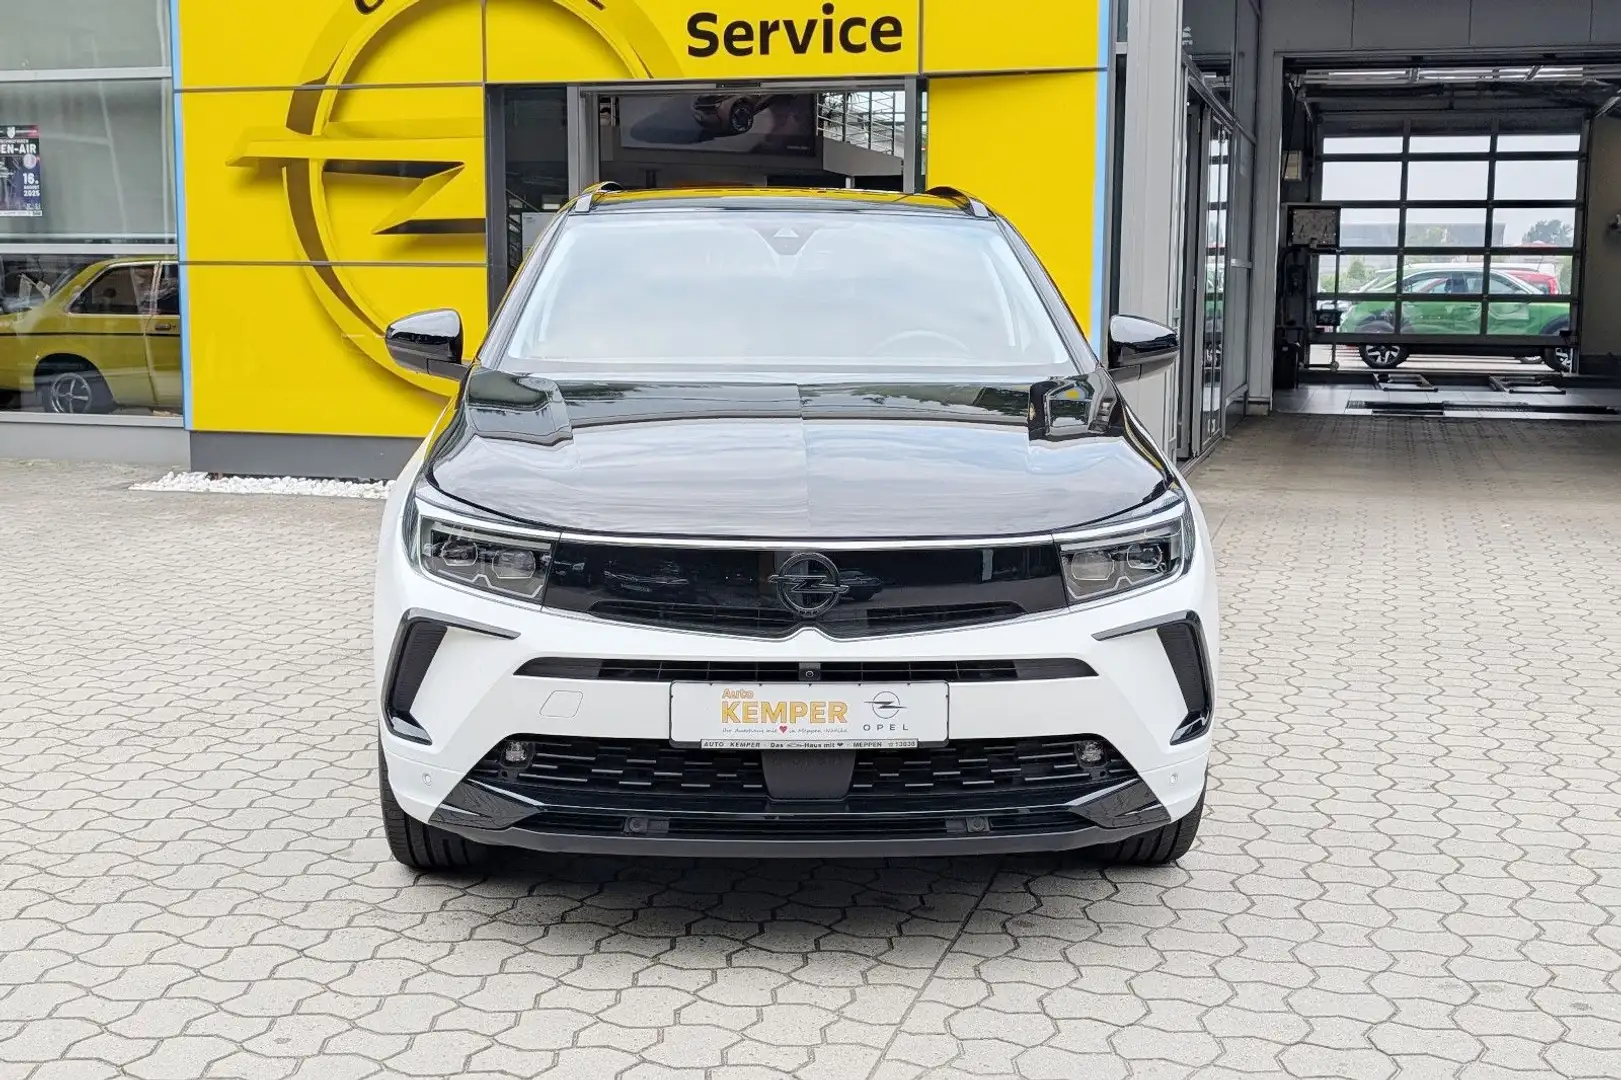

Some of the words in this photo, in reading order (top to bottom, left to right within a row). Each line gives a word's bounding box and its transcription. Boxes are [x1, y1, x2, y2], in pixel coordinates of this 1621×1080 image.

[687, 2, 903, 58] Service
[22, 172, 39, 185] 16.
[23, 189, 40, 197] 2025
[722, 687, 754, 699] Auto
[721, 701, 848, 723] KEMPER
[862, 724, 909, 732] OPEL
